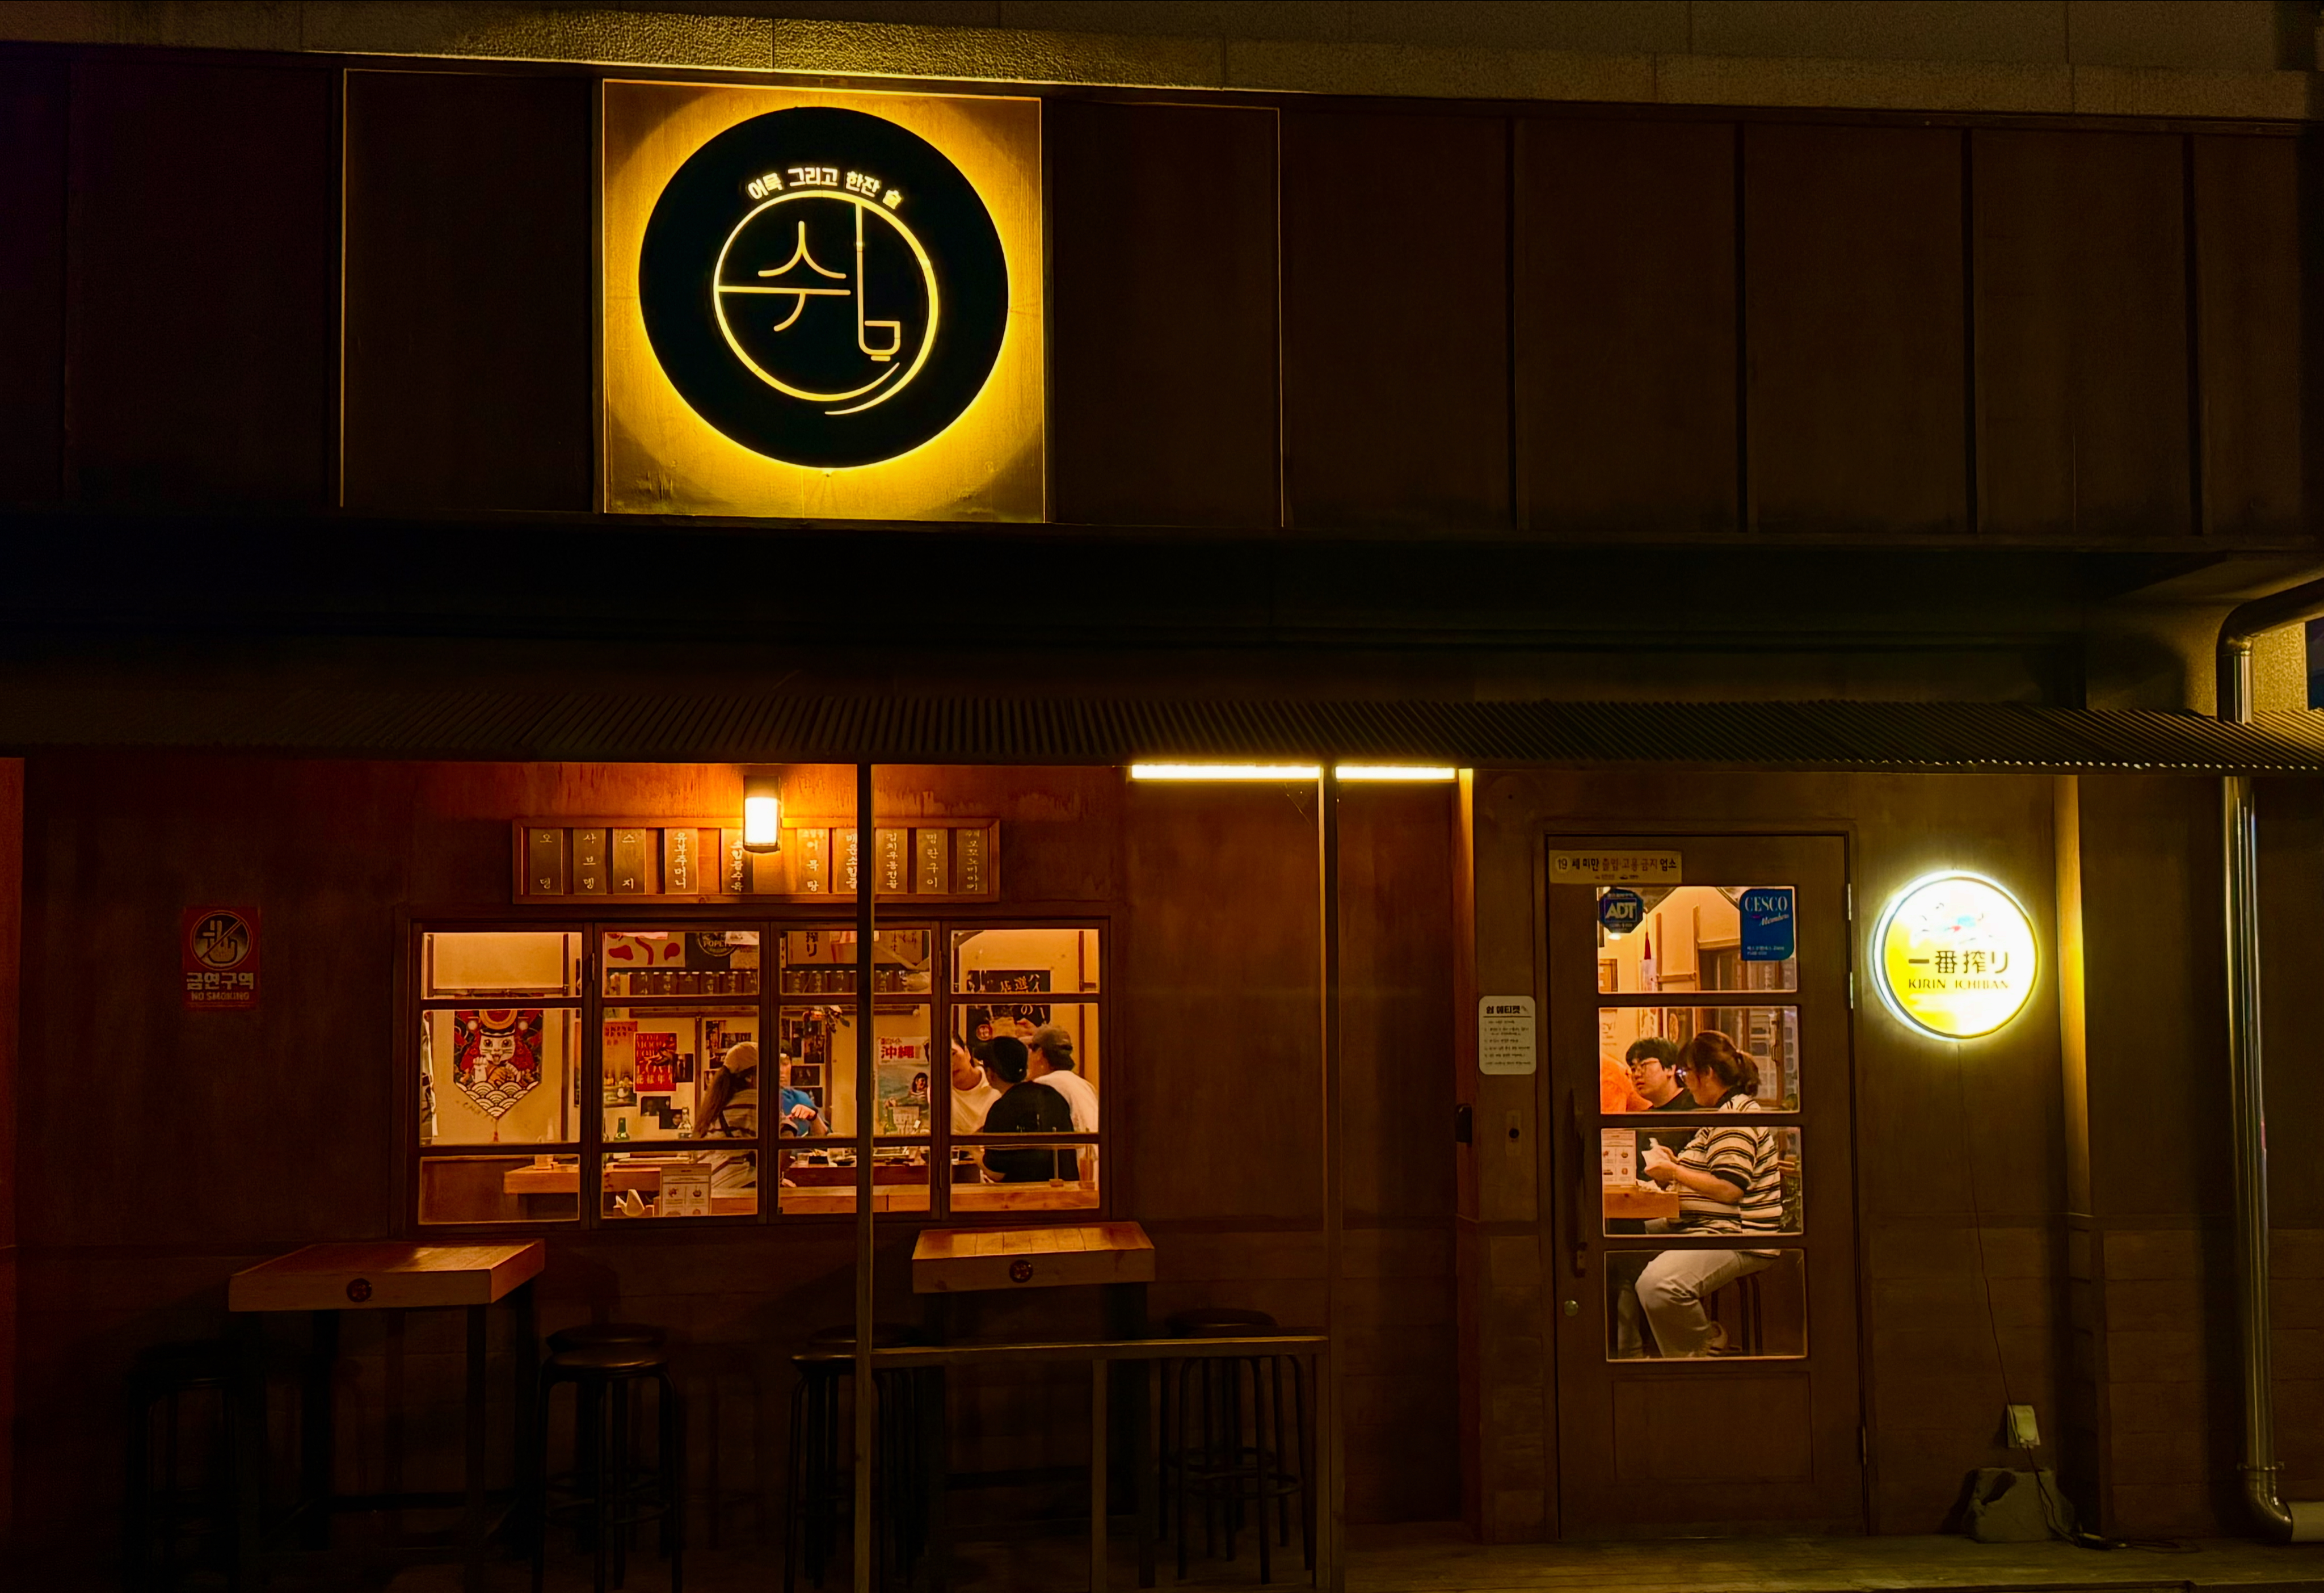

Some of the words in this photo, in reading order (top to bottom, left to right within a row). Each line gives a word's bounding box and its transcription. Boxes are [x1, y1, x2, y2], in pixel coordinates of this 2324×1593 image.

[788, 167, 838, 187] 그리고
[845, 171, 881, 197] 한잔
[621, 833, 636, 889] 스지
[673, 832, 687, 889] 유부주머니
[925, 833, 938, 888] 명란구이
[1582, 858, 1599, 871] 미만
[1605, 902, 1637, 919] ADT
[1745, 896, 1788, 912] CESCO
[1908, 950, 2008, 974] 一番搾り
[186, 972, 254, 990] 금연구역
[1908, 978, 1946, 989] KIRIN
[1955, 980, 2009, 990] ICHIBAN
[191, 991, 204, 1001] NO
[206, 991, 250, 1001] SMOKING
